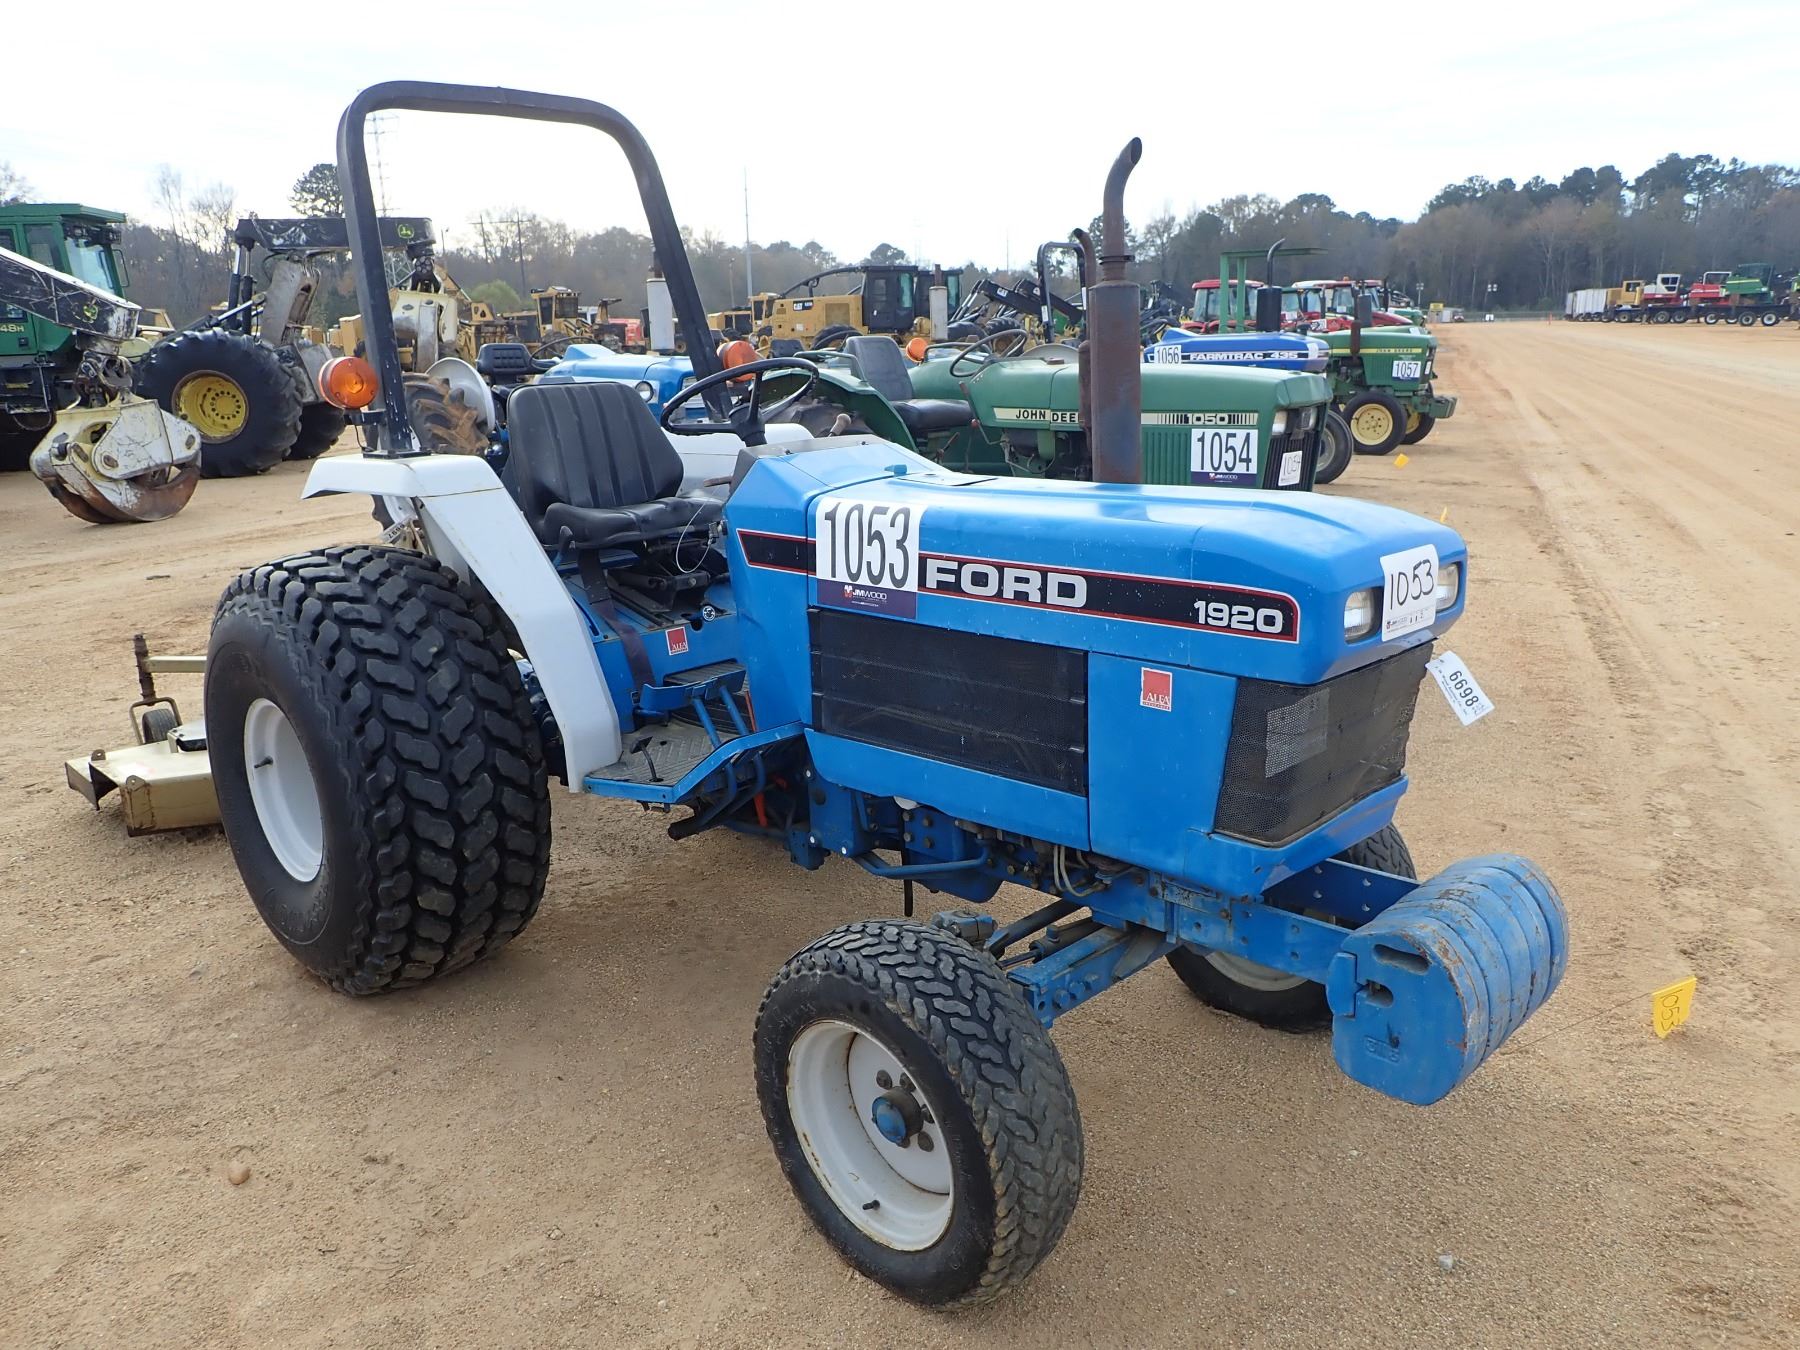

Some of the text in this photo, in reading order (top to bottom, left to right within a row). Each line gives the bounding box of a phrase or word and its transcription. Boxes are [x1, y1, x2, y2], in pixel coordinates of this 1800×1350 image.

[1156, 346, 1180, 364] 1056
[1190, 351, 1298, 361] FARMTRAC 435
[1396, 361, 1419, 377] 1057
[1016, 409, 1080, 423] JOHN DEE
[1186, 413, 1229, 425] 1050
[1197, 431, 1252, 472] 1054
[825, 502, 911, 588] 1053
[926, 558, 1087, 608] FORD
[1390, 559, 1434, 610] 1053
[1194, 600, 1283, 634] 1920
[1146, 692, 1170, 706] ALFA
[1449, 670, 1479, 707] 6698
